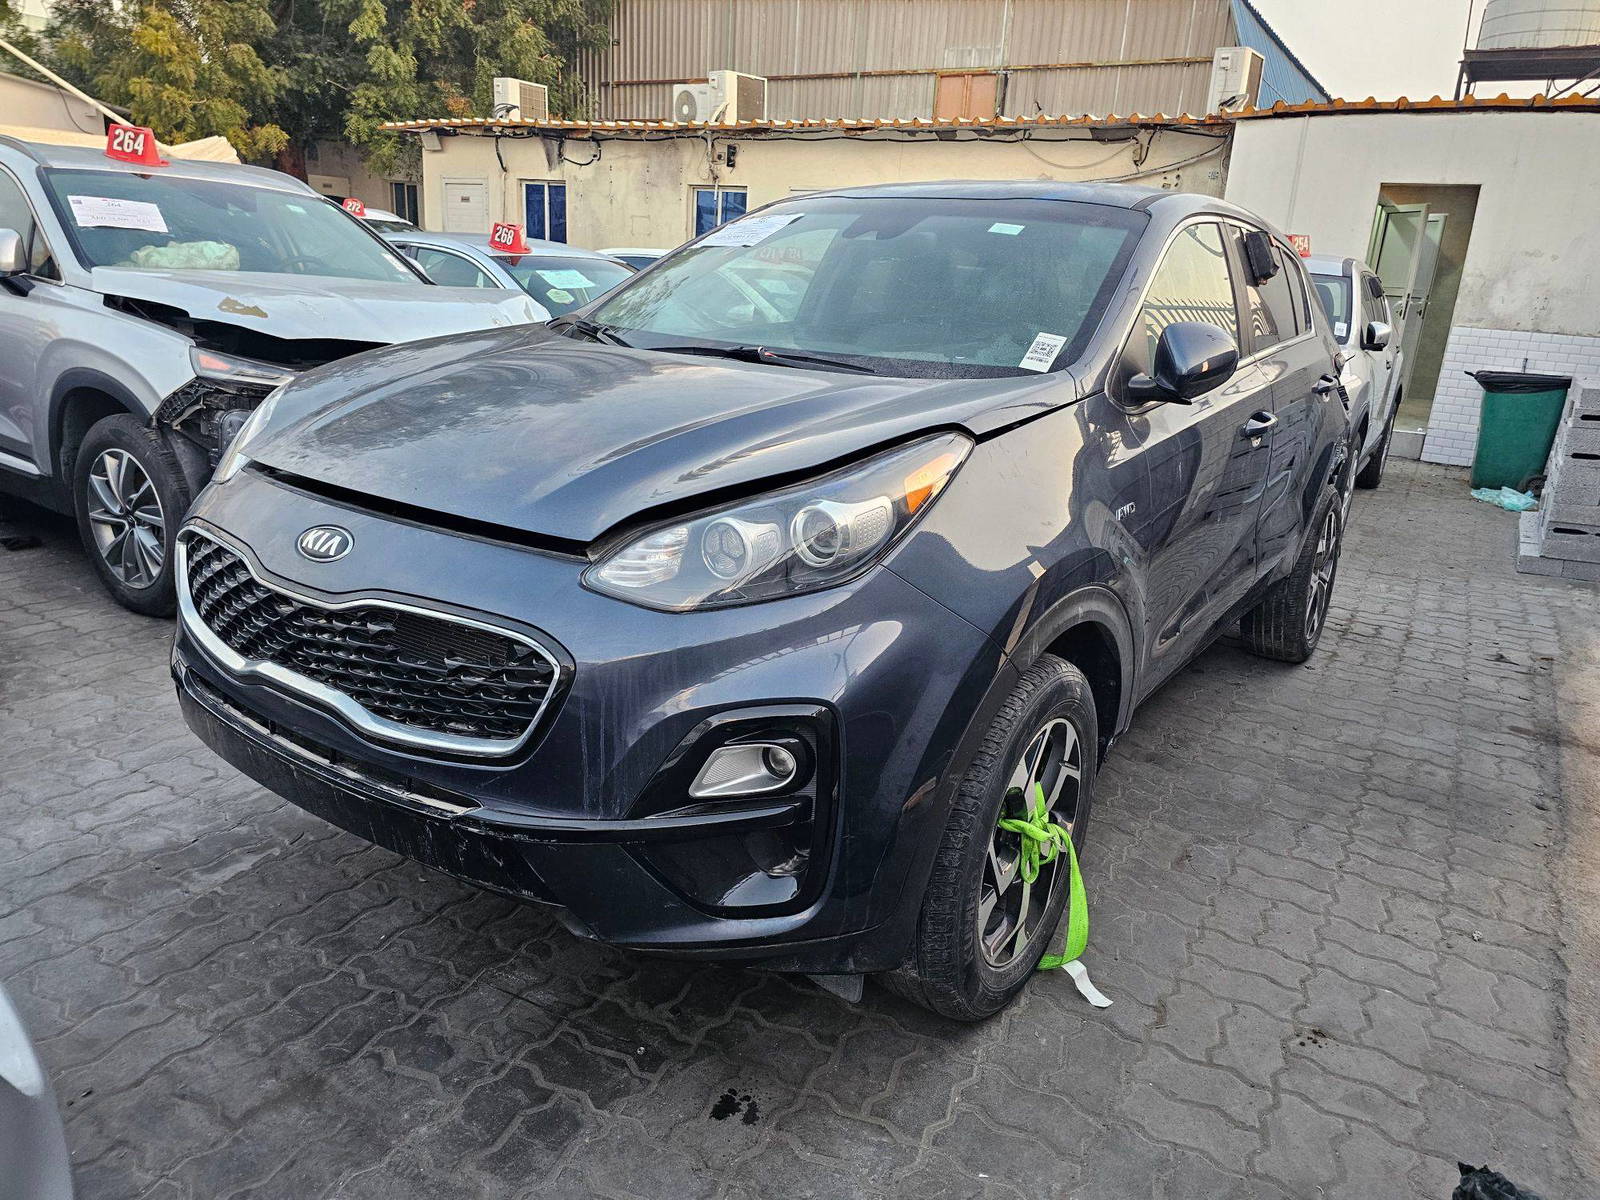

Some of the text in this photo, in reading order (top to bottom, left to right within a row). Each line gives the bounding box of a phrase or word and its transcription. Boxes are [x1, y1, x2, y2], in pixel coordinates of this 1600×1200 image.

[112, 128, 145, 156] 264
[346, 200, 361, 213] 272
[494, 225, 514, 246] 268
[301, 529, 343, 557] KIA
